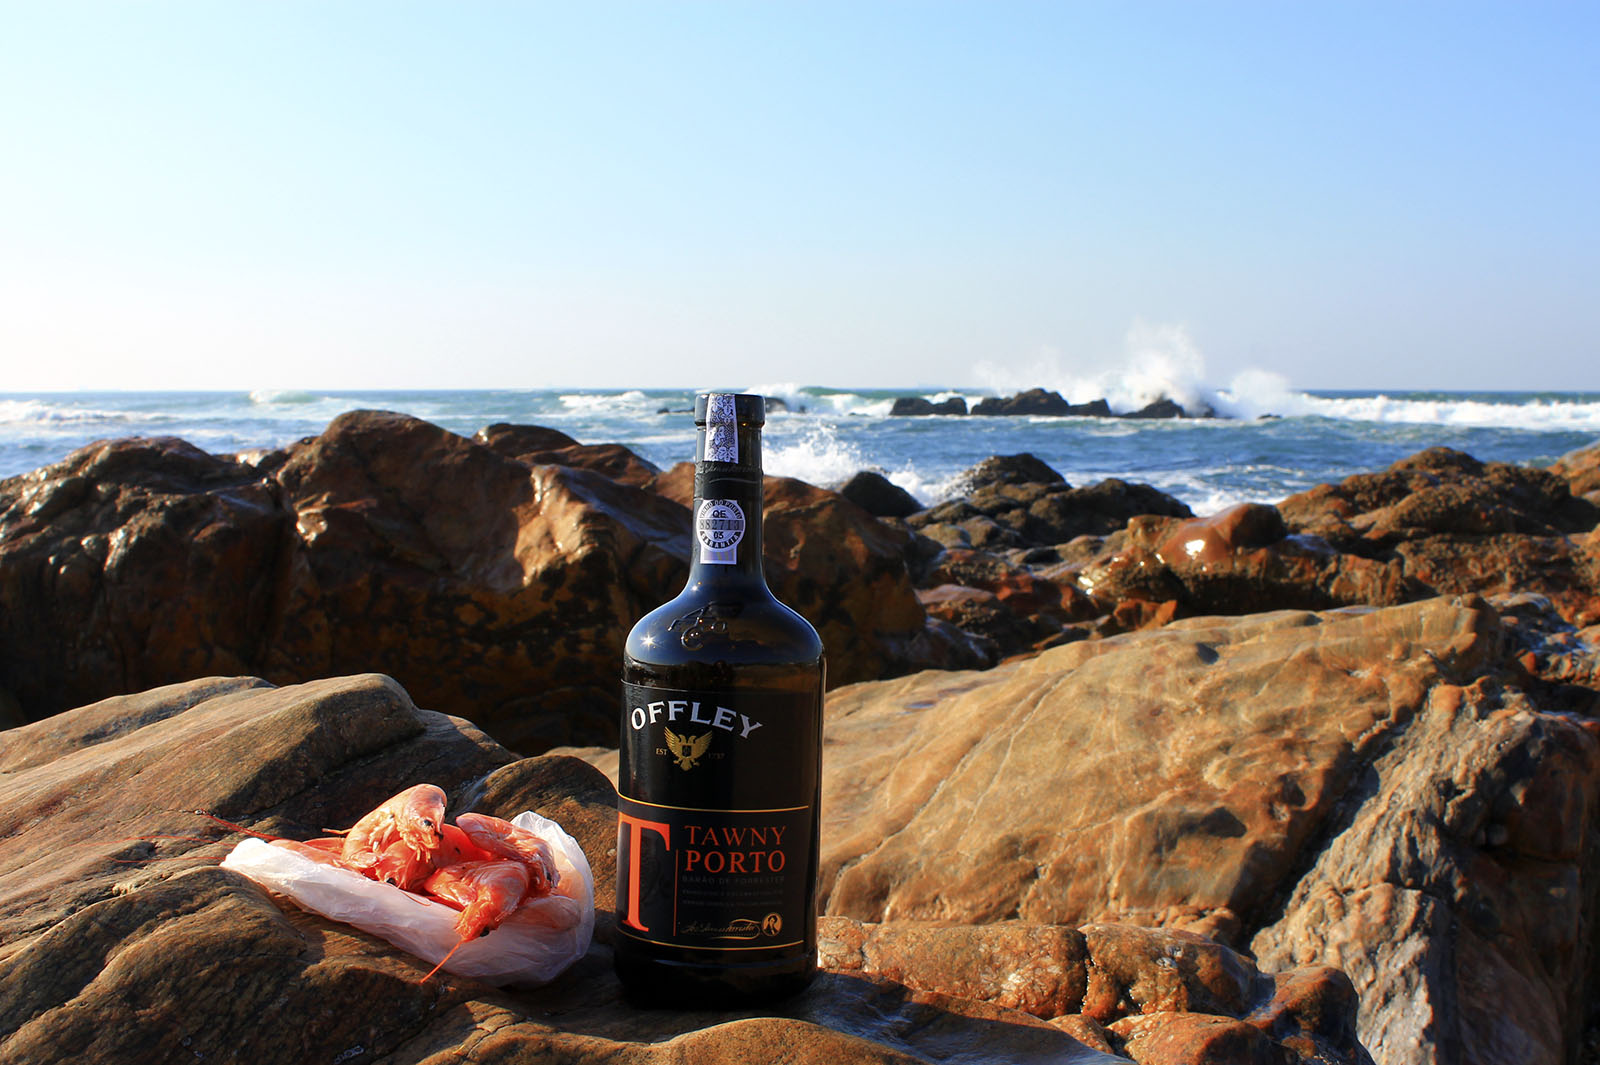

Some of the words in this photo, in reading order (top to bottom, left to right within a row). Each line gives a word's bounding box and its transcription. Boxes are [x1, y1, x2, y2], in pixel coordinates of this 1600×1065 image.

[630, 699, 764, 740] OFFLEY
[655, 747, 669, 757] EST
[682, 825, 788, 847] TAWNY
[617, 811, 671, 933] T
[684, 849, 787, 874] PORTO
